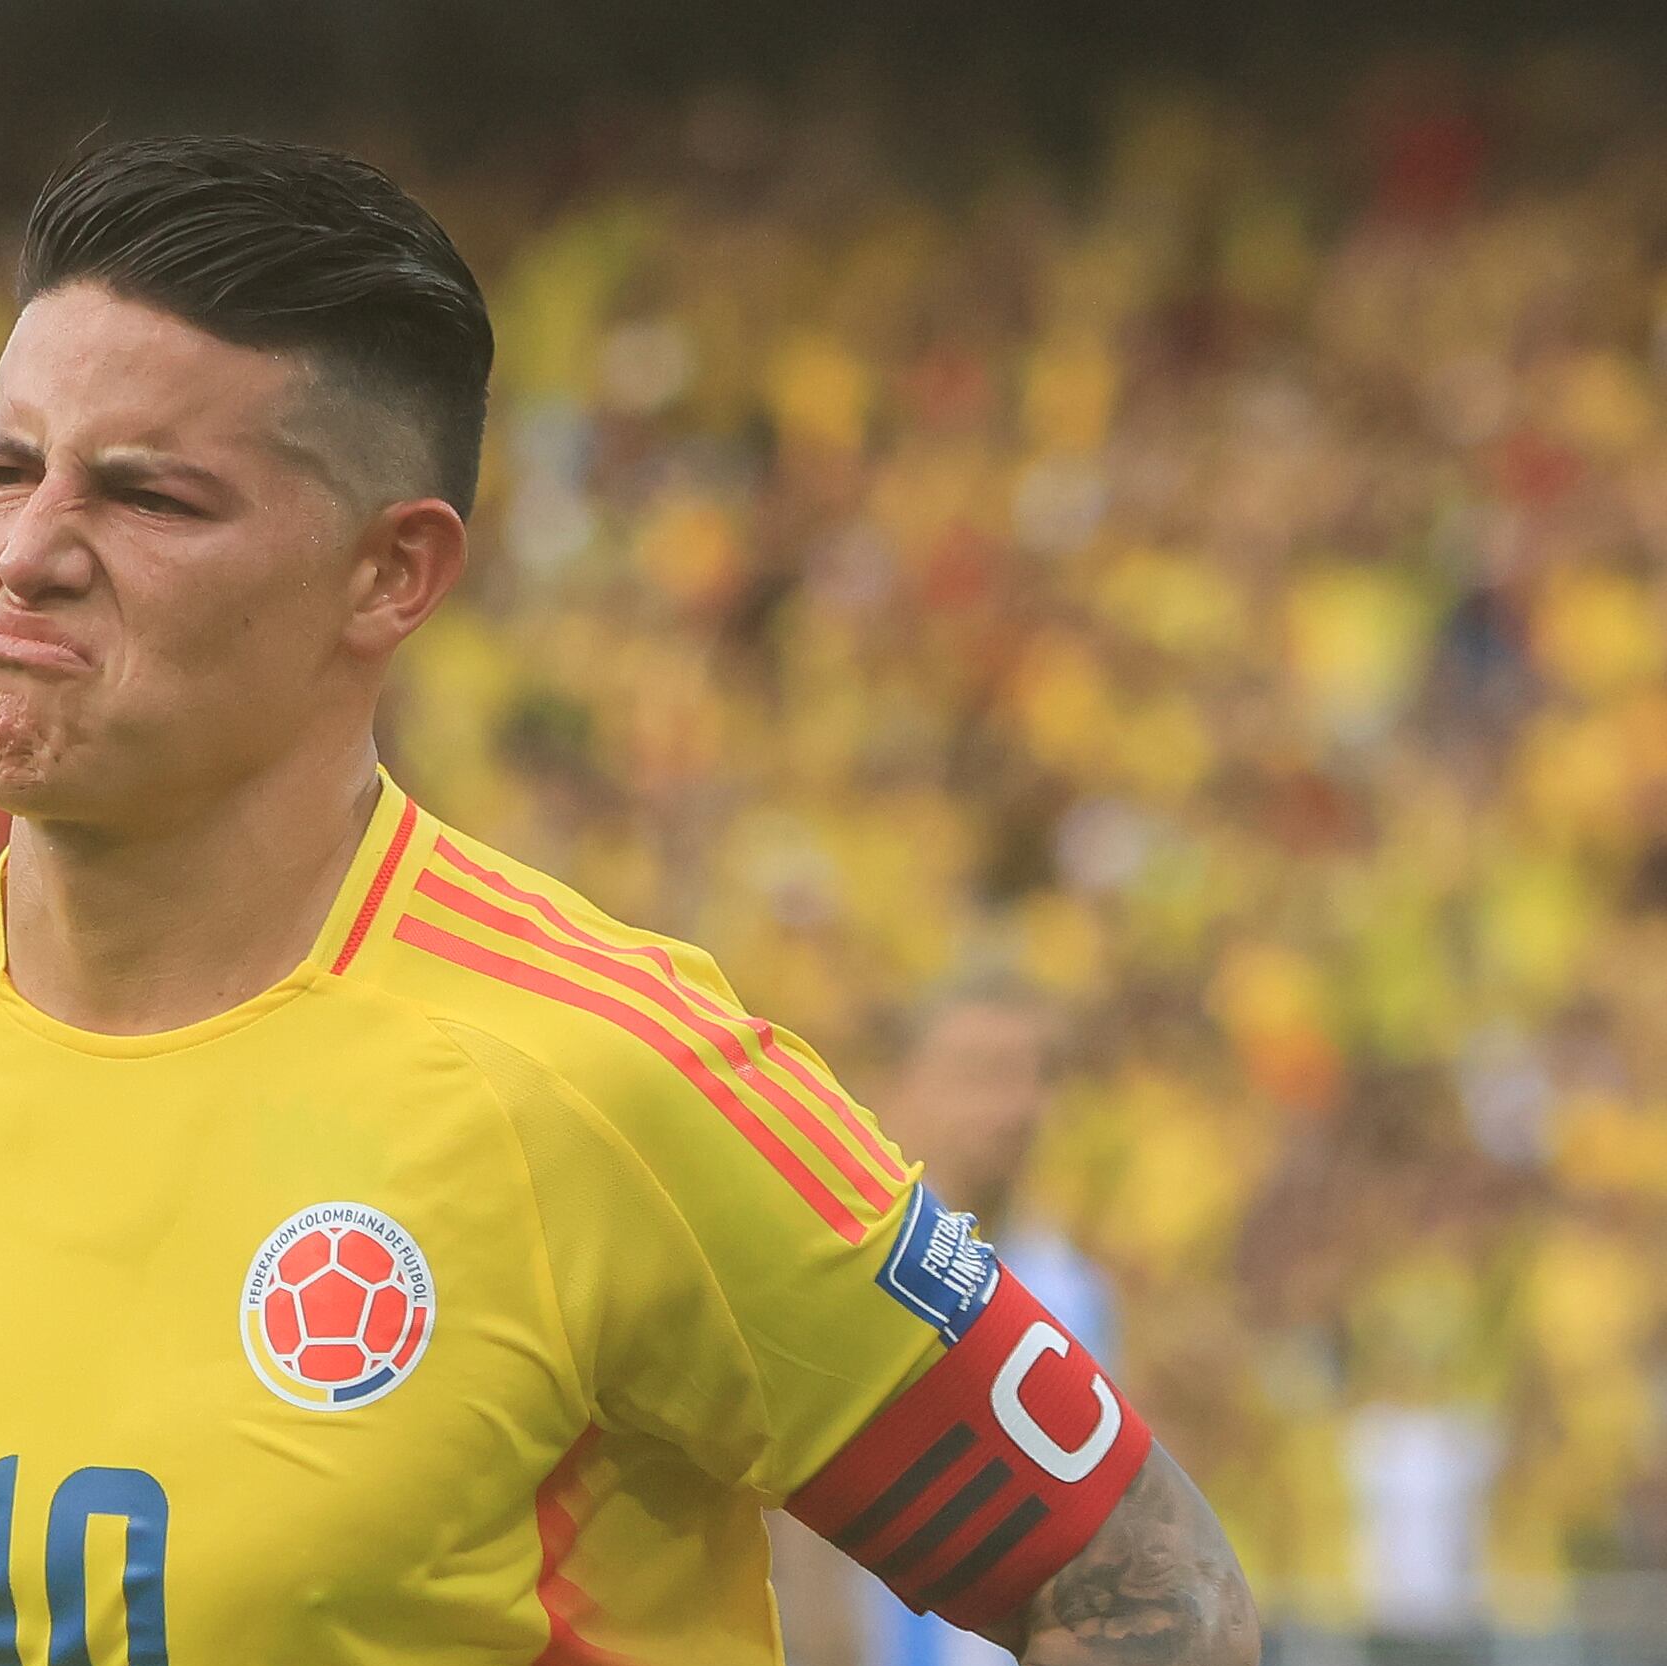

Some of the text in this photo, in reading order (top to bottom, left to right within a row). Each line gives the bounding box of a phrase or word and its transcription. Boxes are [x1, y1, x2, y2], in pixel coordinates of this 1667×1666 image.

[248, 1208, 428, 1305] FEDERACIÓN COLOMBIANA DE FÚTBOL
[990, 1320, 1123, 1483] C
